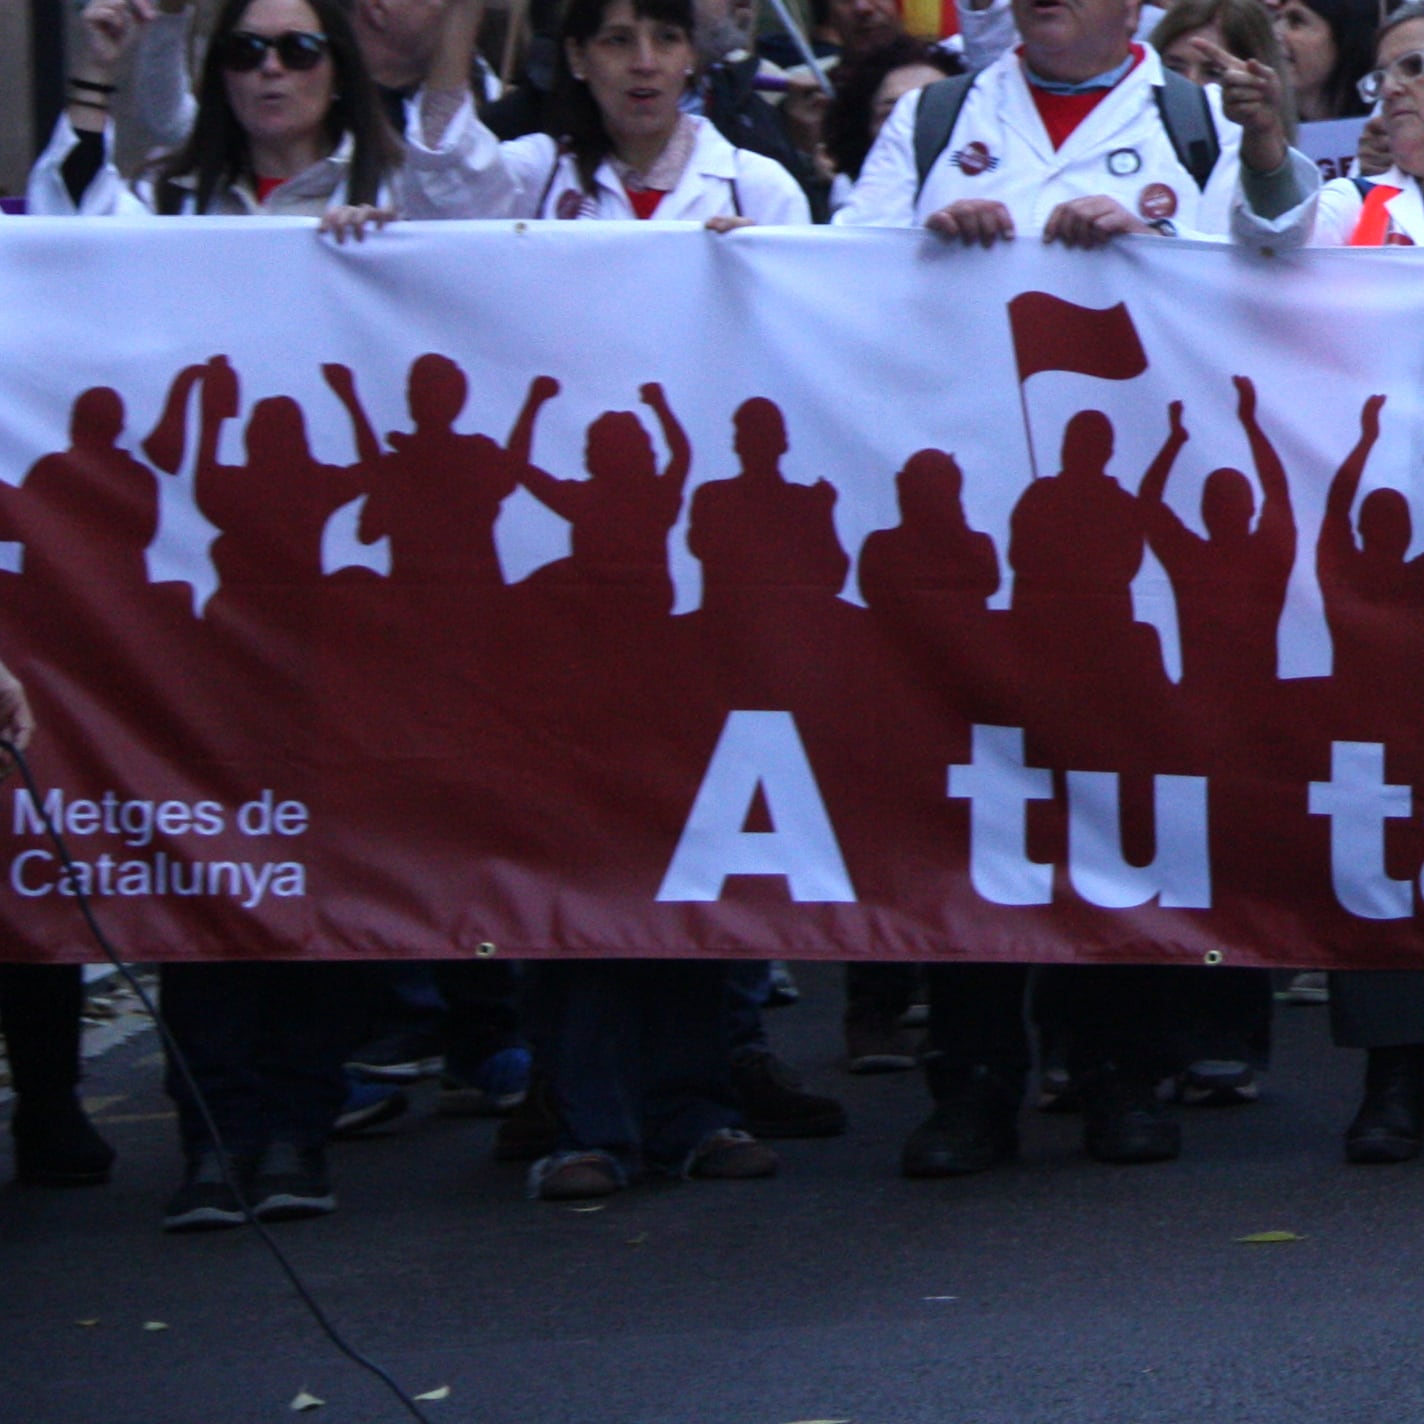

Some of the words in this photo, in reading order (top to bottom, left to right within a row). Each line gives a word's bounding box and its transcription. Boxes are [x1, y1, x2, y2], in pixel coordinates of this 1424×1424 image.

[12, 787, 227, 848] Metges
[235, 787, 311, 837] de
[654, 708, 860, 904] A
[946, 721, 1213, 910] tu
[9, 848, 307, 909] Catalunya
